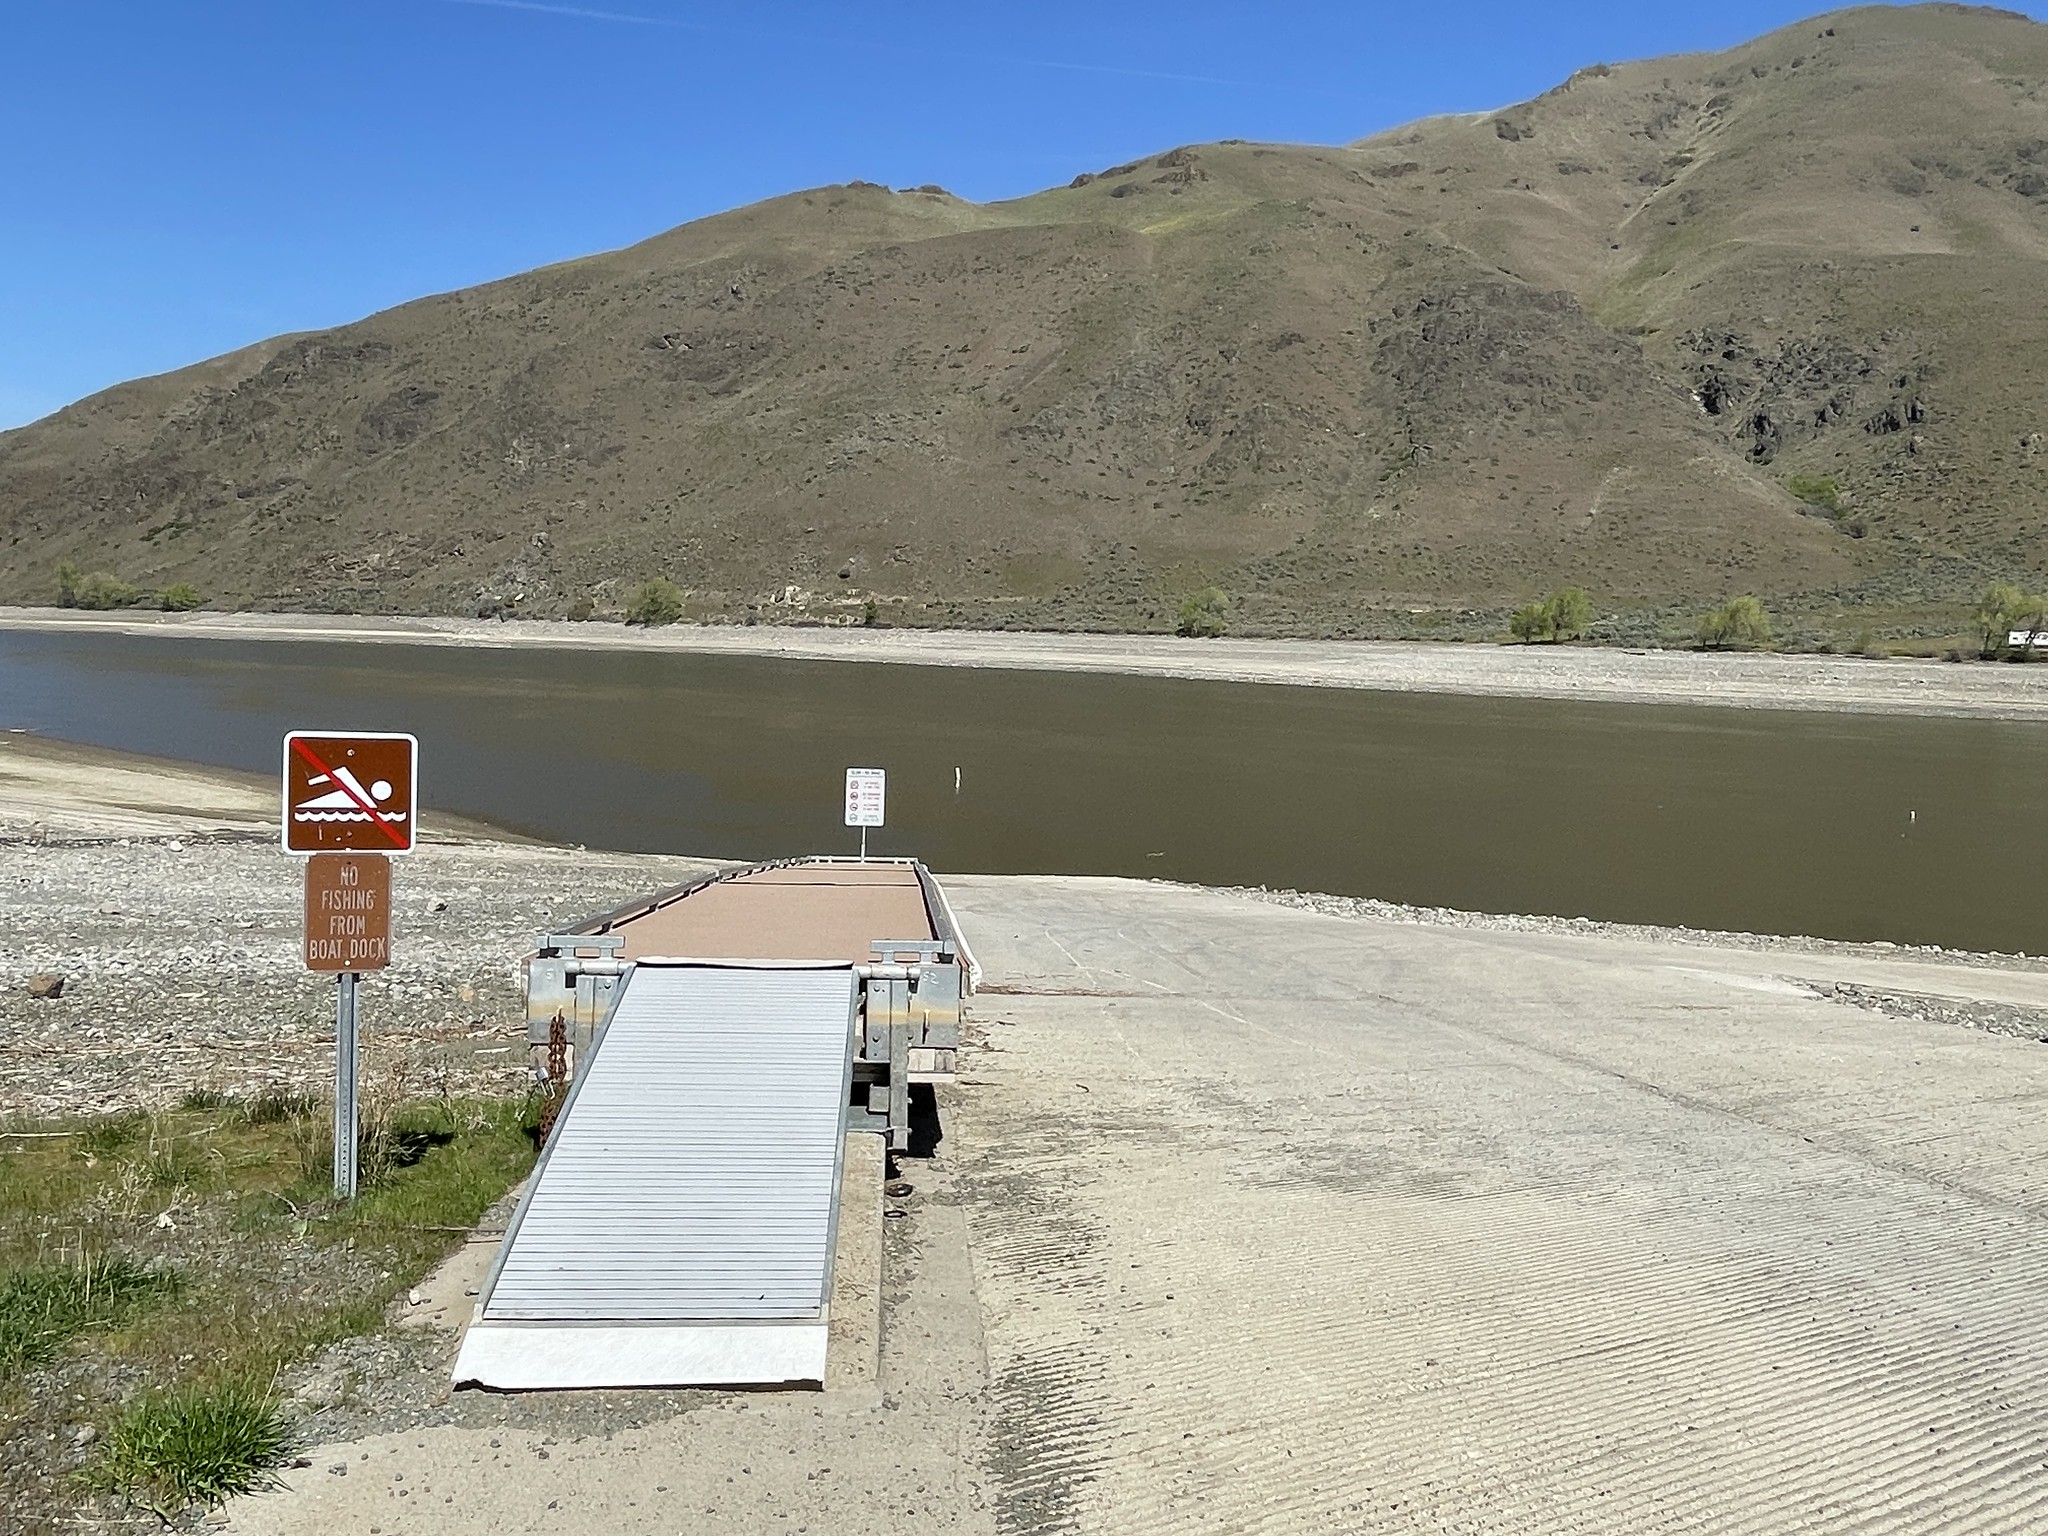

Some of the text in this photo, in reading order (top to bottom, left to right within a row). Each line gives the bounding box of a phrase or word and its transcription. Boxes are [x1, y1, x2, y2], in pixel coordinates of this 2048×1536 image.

[340, 866, 358, 886] NO
[321, 889, 376, 910] FISHING
[329, 915, 366, 935] FROM
[309, 937, 386, 960] BOAT DOCK
